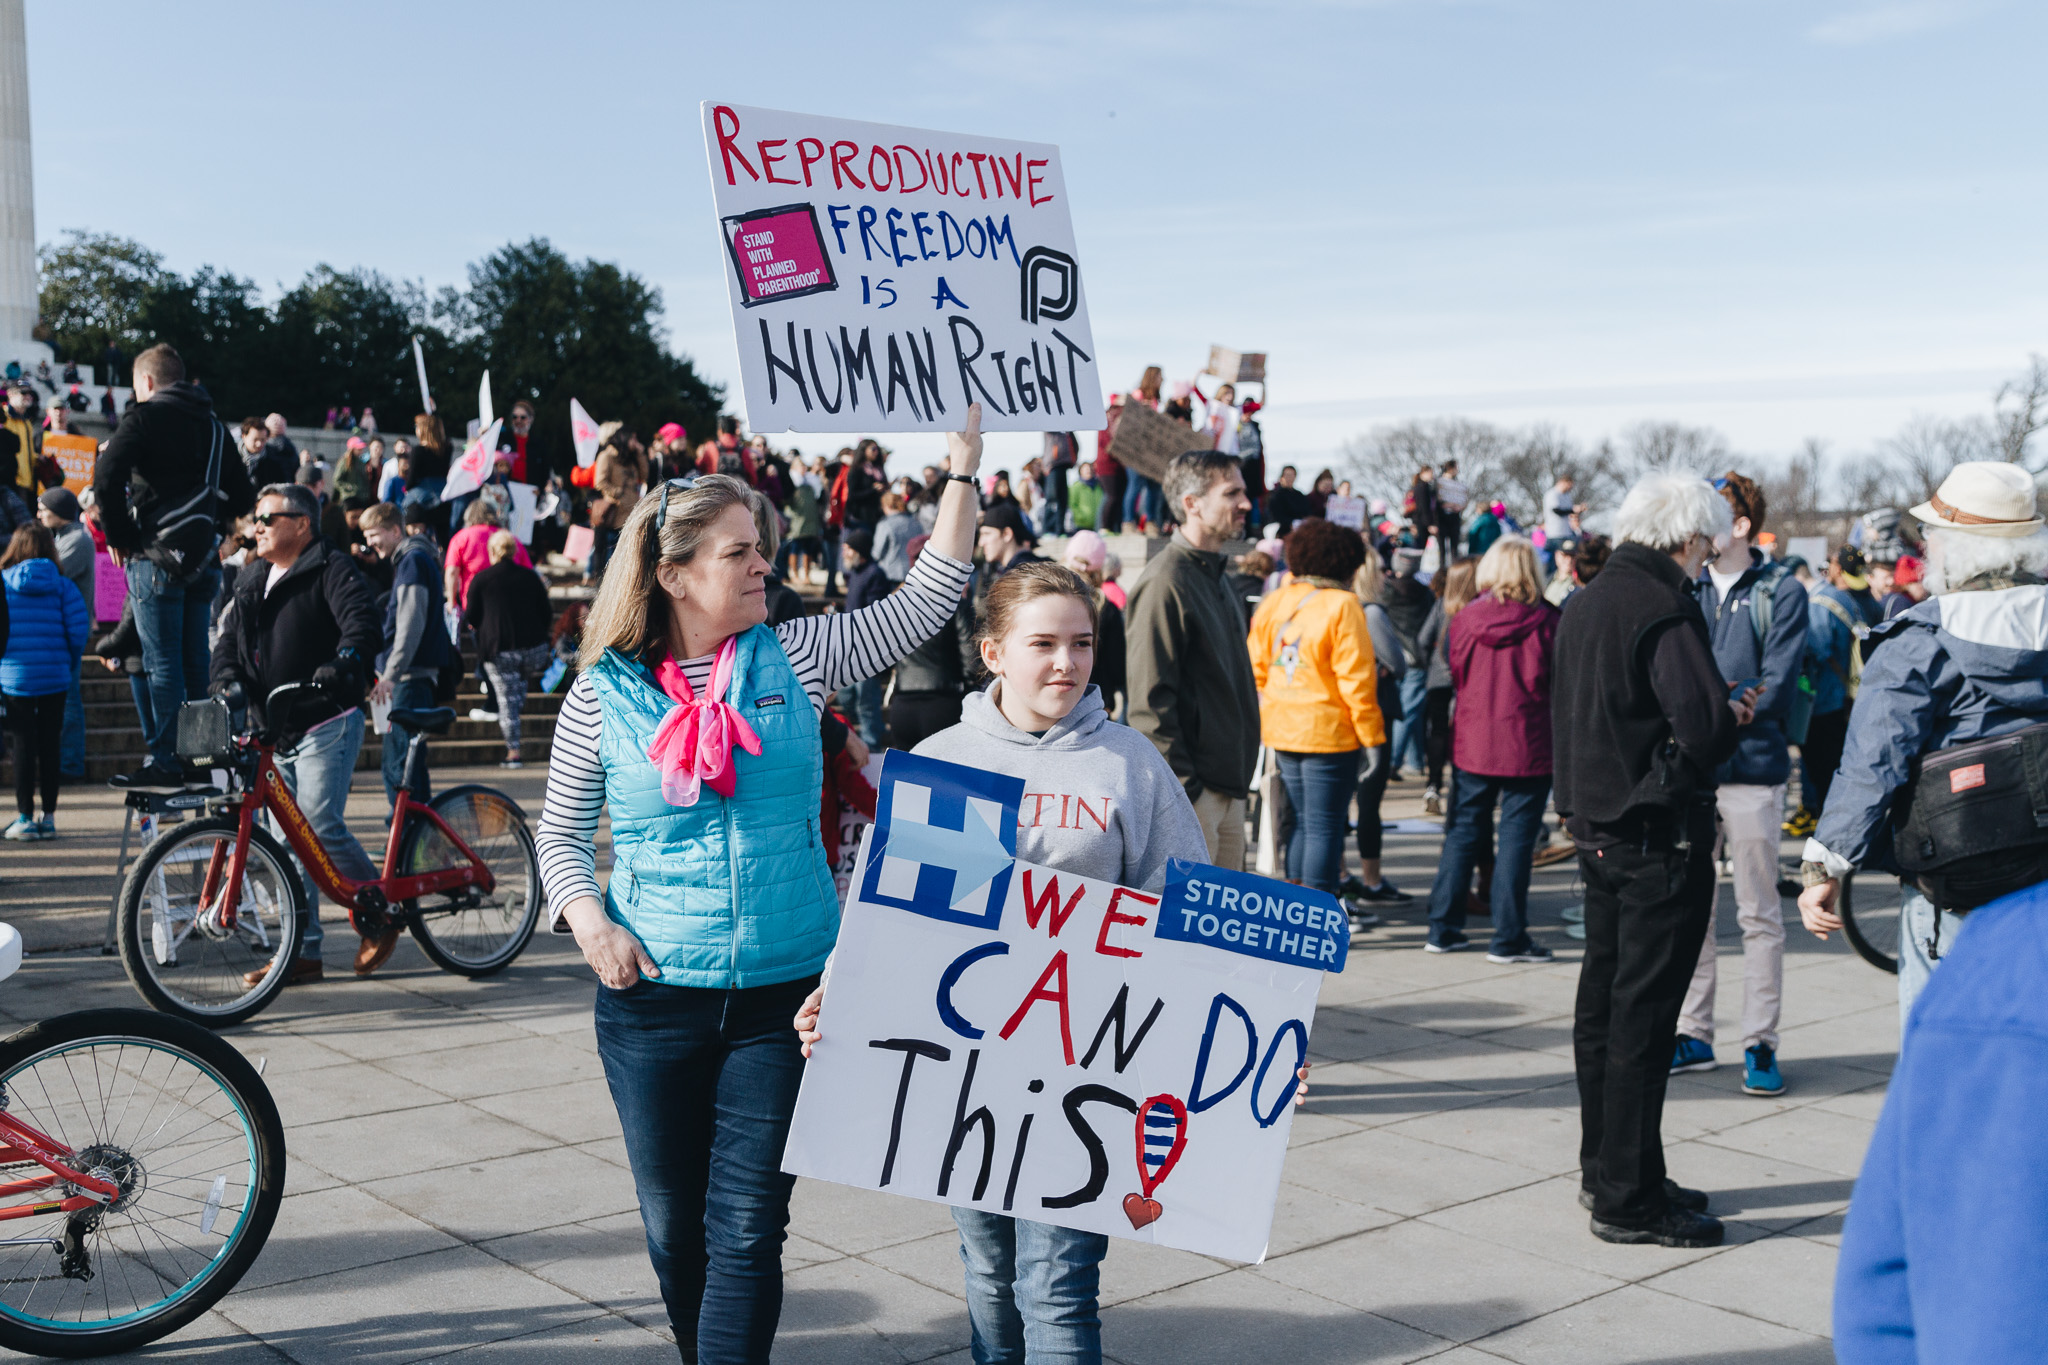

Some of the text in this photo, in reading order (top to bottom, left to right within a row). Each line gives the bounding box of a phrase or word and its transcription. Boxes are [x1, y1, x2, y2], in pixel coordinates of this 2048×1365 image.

[712, 105, 1054, 208] REPRODUCTIVE
[742, 230, 775, 249] STAND
[747, 247, 774, 264] WITH
[827, 204, 1021, 267] FREEDOM
[752, 259, 797, 280] PLANNED
[861, 275, 969, 310] IS A
[758, 315, 1091, 423] HUMAN RIGHT
[56, 456, 94, 472] OISY
[1017, 793, 1112, 833] TIN
[1022, 868, 1160, 959] WE
[1184, 879, 1343, 934] STRONGER
[1180, 908, 1338, 963] TOGETHER
[936, 941, 1309, 1128] CAN DO
